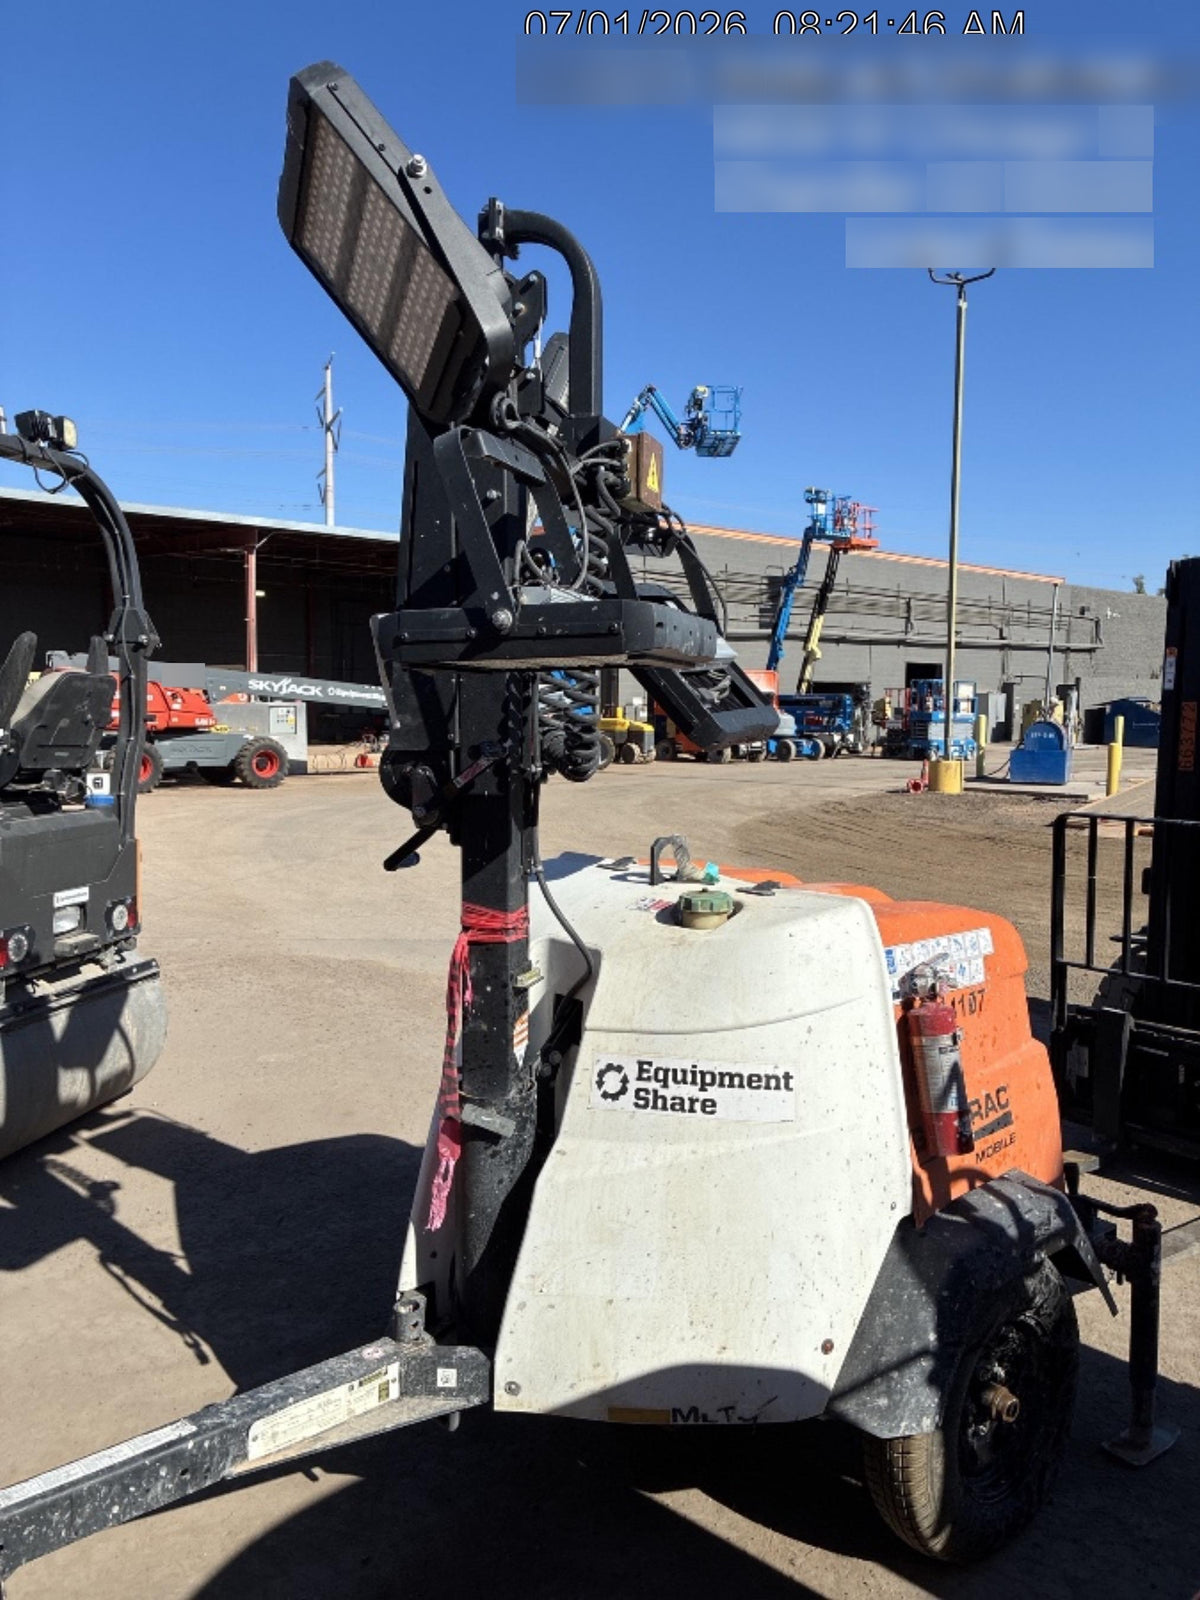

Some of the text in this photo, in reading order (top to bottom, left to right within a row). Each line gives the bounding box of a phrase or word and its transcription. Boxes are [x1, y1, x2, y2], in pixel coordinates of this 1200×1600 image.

[248, 678, 323, 697] SKYJACK
[941, 988, 985, 1018] 1107
[636, 1060, 794, 1092] Equipment
[633, 1088, 717, 1115] Share
[975, 1132, 1017, 1164] MOBILE
